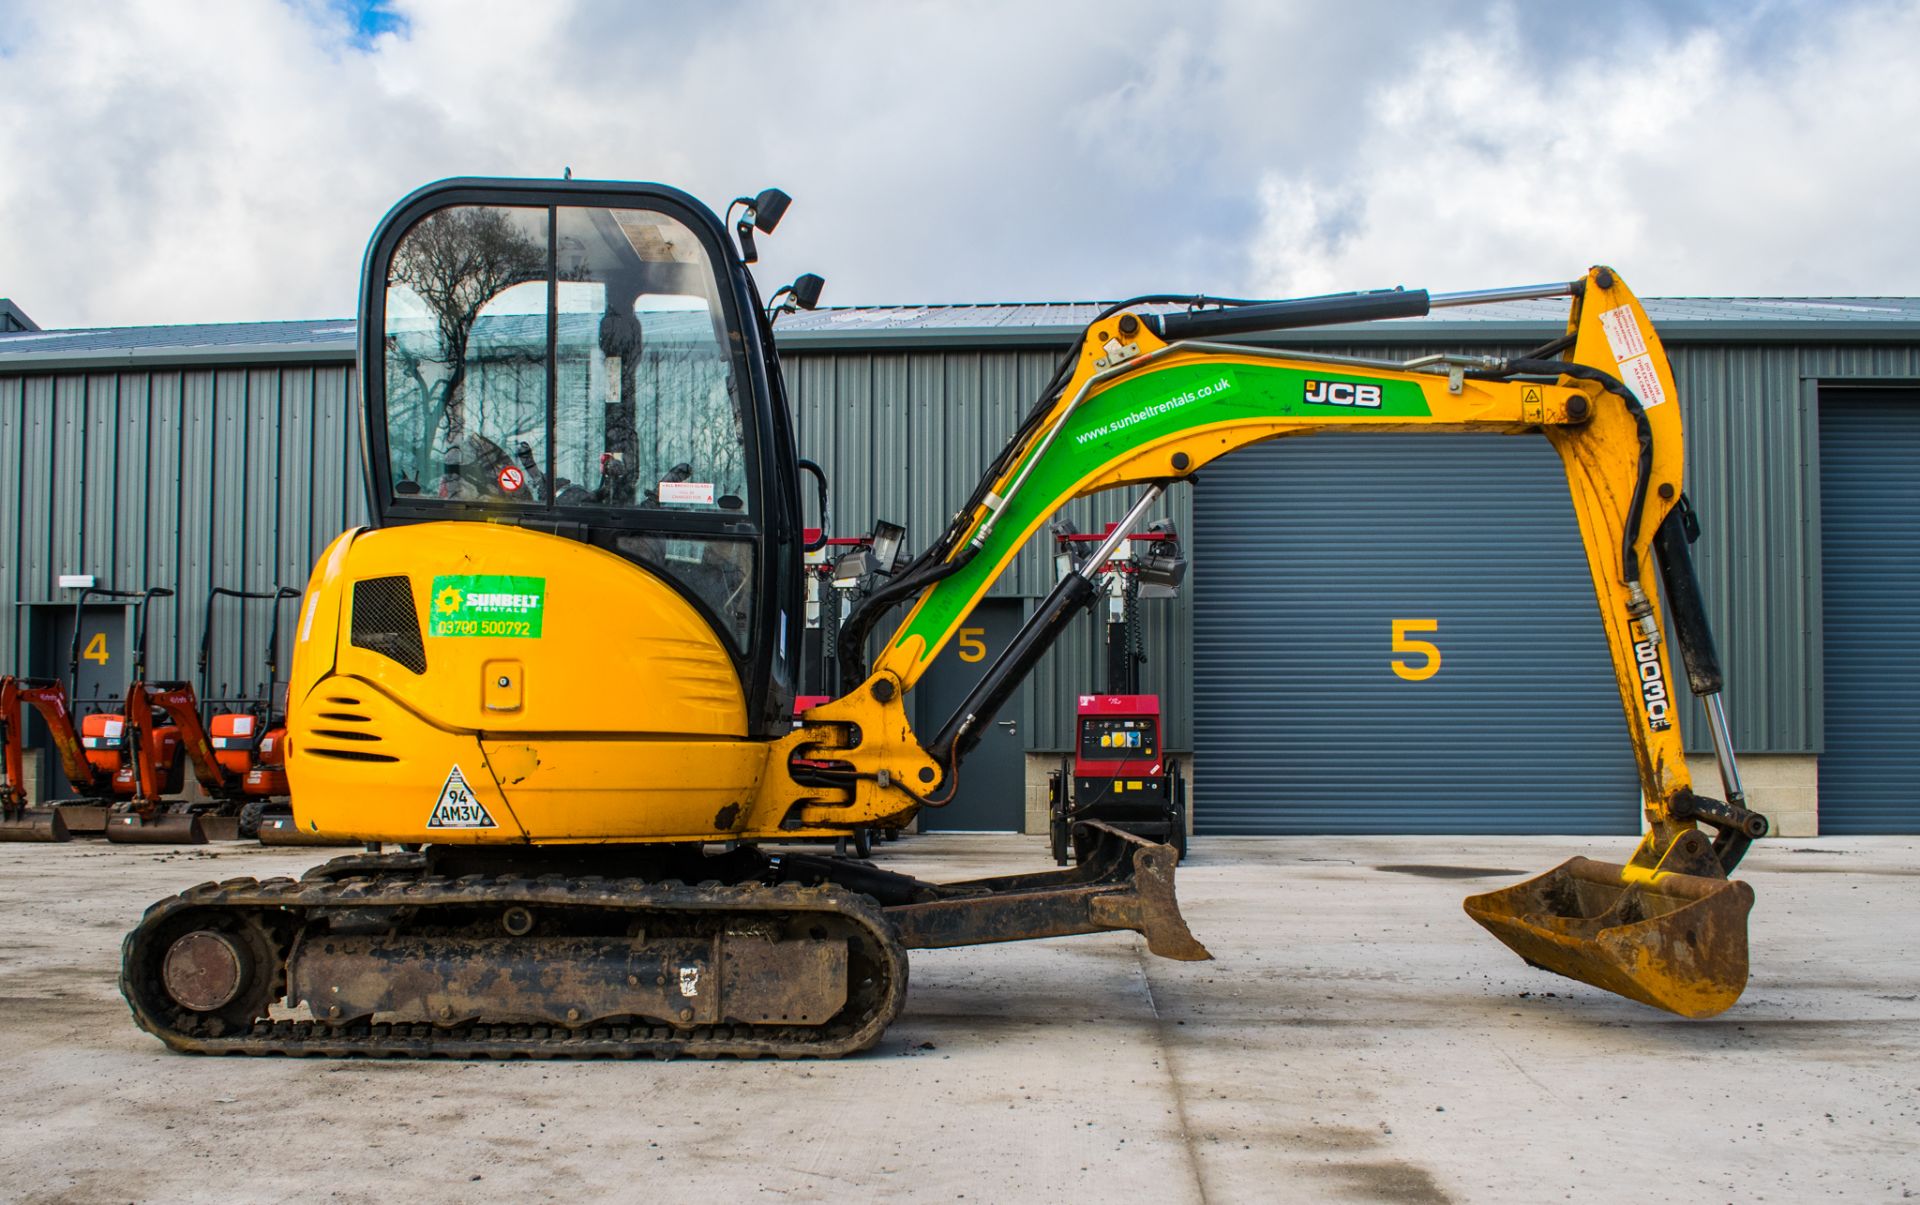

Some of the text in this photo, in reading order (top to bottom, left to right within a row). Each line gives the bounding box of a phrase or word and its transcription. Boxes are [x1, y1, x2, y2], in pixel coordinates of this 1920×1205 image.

[1305, 382, 1380, 407] JCB
[1076, 378, 1230, 444] www.sunbeltrentals.co.uk
[466, 593, 540, 608] SUNBELT
[439, 621, 531, 636] 03700 500792
[83, 632, 110, 666] 4
[958, 627, 987, 663] 5
[1391, 618, 1441, 681] 5
[1635, 641, 1669, 720] 8030
[449, 790, 467, 805] 94
[441, 806, 480, 822] AM3V
